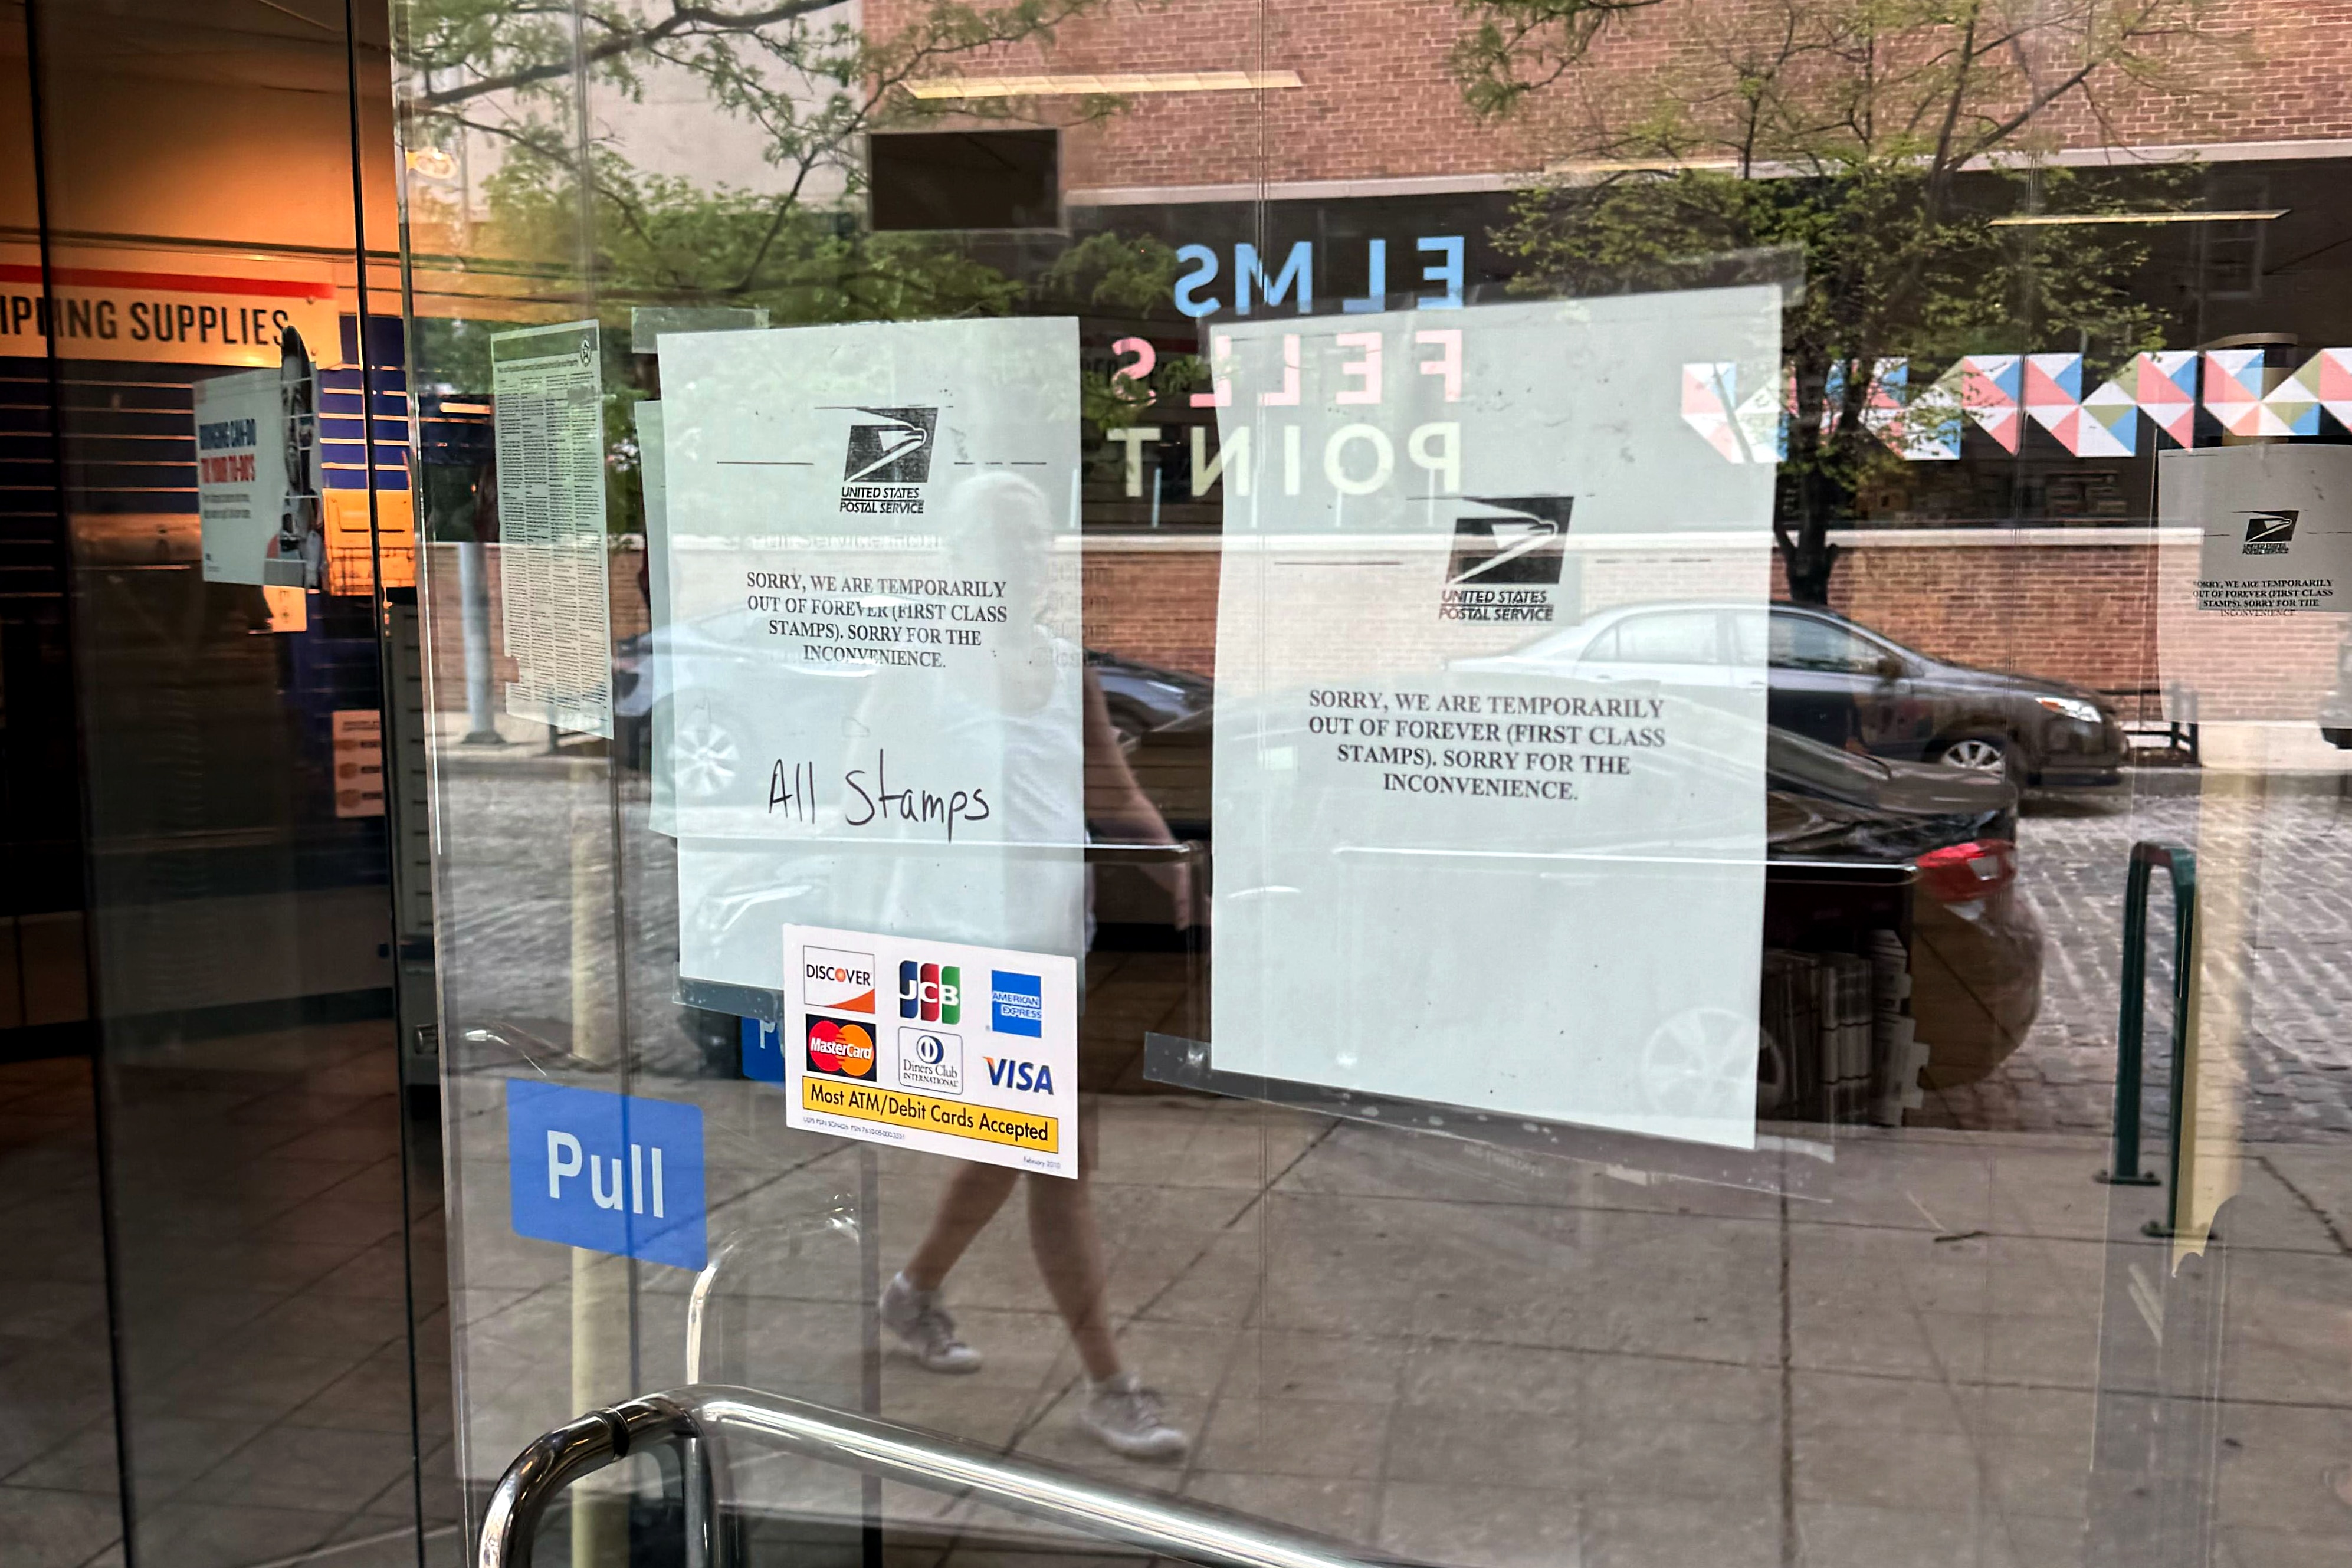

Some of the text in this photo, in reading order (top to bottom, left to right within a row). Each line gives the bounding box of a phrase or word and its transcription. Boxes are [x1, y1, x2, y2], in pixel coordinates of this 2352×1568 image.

[130, 302, 288, 345] SUPPLIES
[841, 487, 920, 499] UNITED STATES
[839, 501, 924, 514] POSTAL SERVICE
[747, 572, 1006, 598] SORRY, WE ARE TEMPORARILY
[2193, 580, 2223, 589] ORRY,
[2262, 579, 2333, 588] TEMPORARILY
[2212, 590, 2223, 598] OF
[747, 595, 1008, 622] OUT OF FOREVER (FIRST CLASS
[1441, 590, 1547, 604] UNITED STATES
[1438, 607, 1554, 621] POSTAL SERVICE
[769, 621, 982, 646] STAMPS). SORRY FOR THE
[803, 645, 946, 668] INCONVENIENCE.
[1309, 690, 1664, 719] SORRY, WE ARE TEMPORARILY
[1309, 717, 1666, 747] OUT OF FOREVER (FIRST CLASS
[1337, 744, 1631, 775] STAMPS). SORRY FOR THE
[769, 749, 989, 843] All Stamps
[1384, 773, 1578, 801] INCONVENIENCE.
[806, 964, 871, 986] DISCOVER
[898, 980, 959, 1006] JCB
[992, 992, 1039, 1006] AMERICAN
[1002, 1006, 1041, 1019] EXPRESS
[810, 1036, 872, 1060] MasterCard
[903, 1059, 957, 1078] Diners Club
[983, 1056, 1054, 1095] VISA
[811, 1084, 1048, 1141] Most ATM/Debit Cards Accepted
[547, 1130, 664, 1218] Pull
